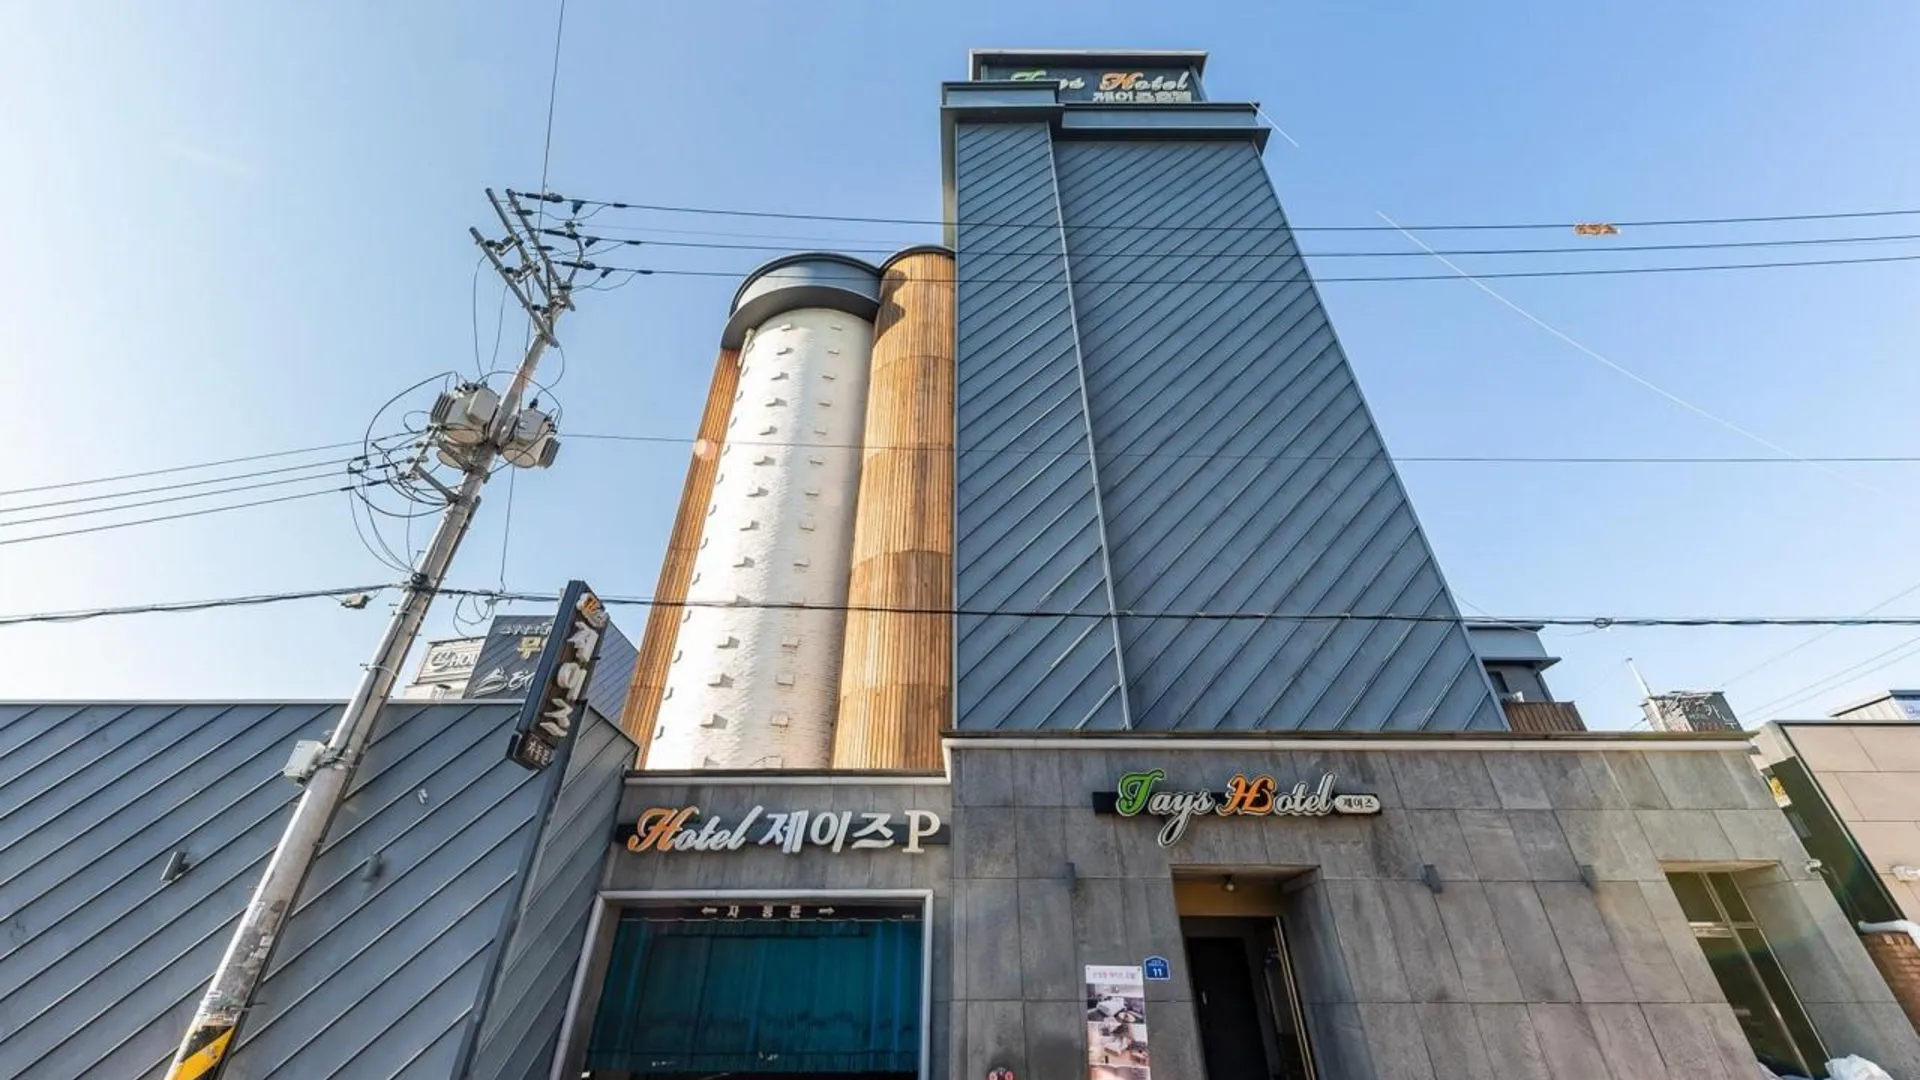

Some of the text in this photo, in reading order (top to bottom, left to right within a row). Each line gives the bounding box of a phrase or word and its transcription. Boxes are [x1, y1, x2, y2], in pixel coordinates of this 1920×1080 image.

[1099, 71, 1190, 91] Hotel
[1217, 770, 1337, 818] Hotel
[627, 805, 940, 854] Hotel 제이즈 P
[1152, 968, 1162, 977] 11
